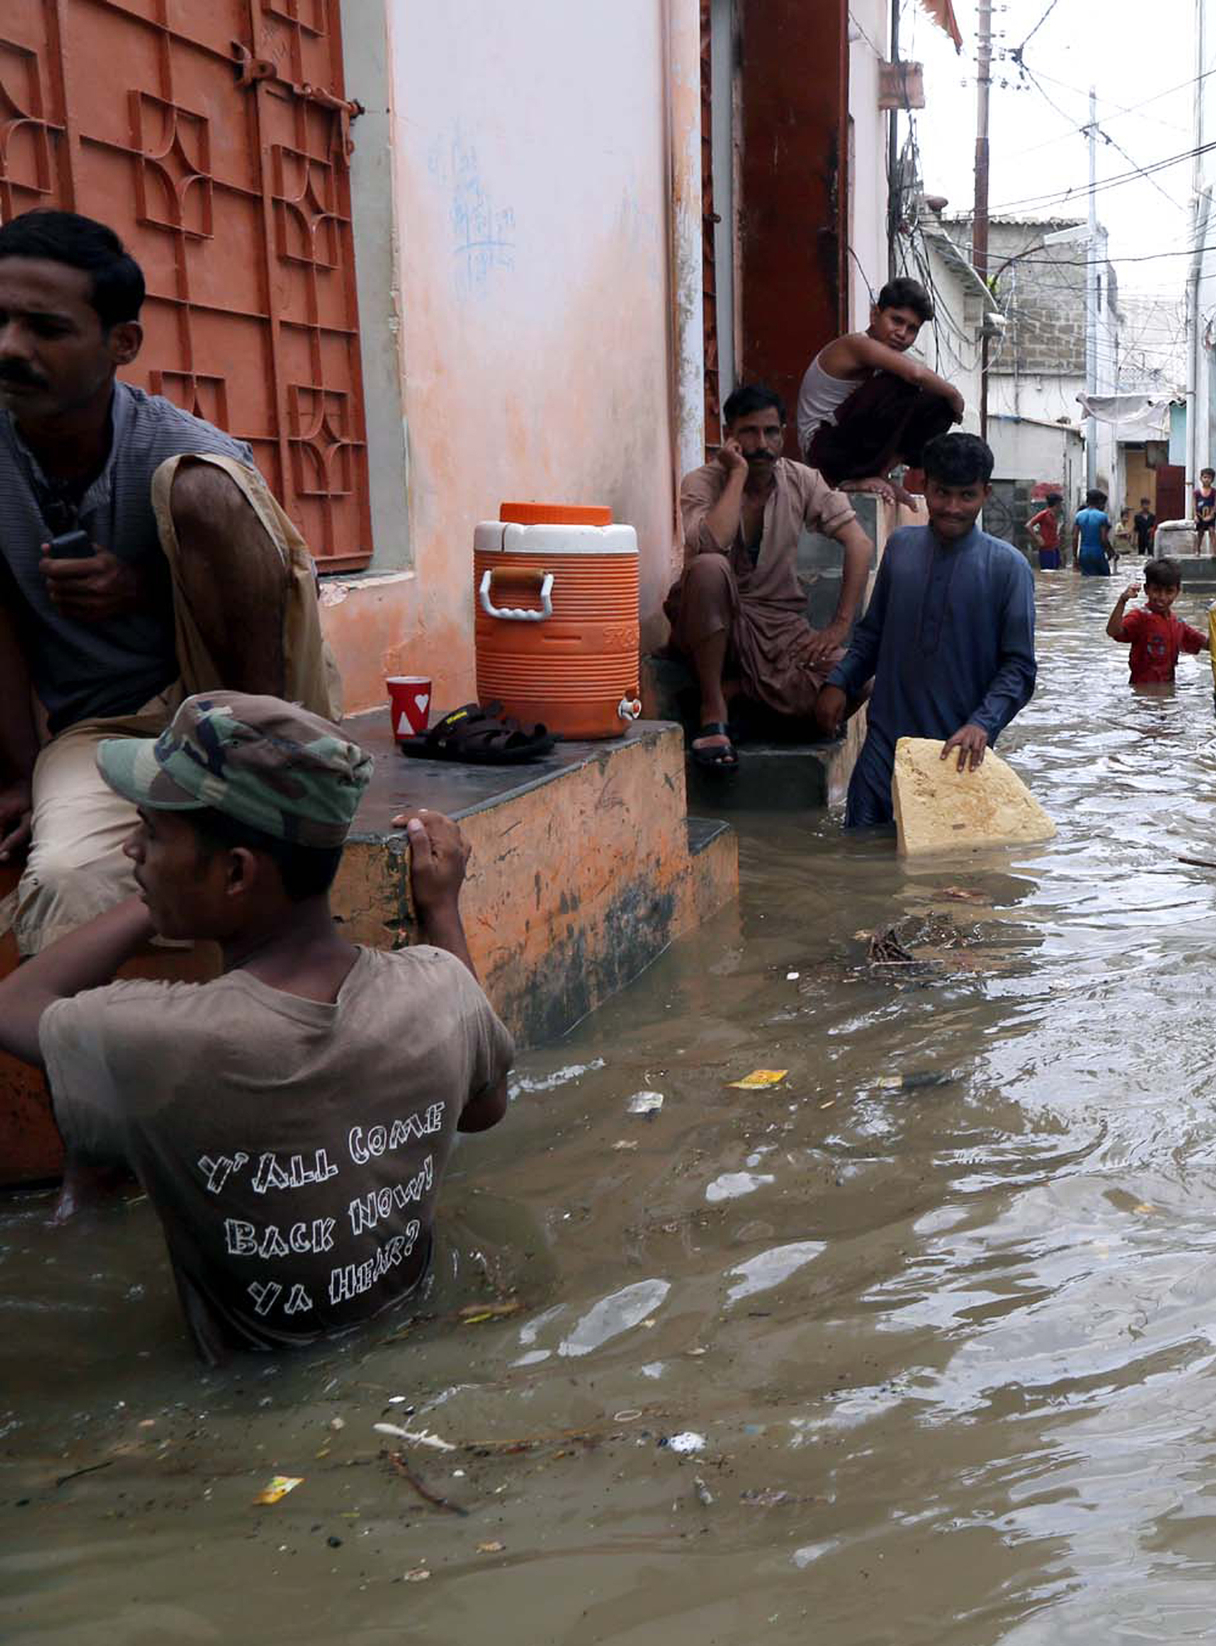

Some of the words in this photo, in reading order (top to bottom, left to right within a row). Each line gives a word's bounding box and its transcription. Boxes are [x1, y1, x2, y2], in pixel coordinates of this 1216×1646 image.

[197, 1149, 339, 1194] Y'ALL
[348, 1101, 446, 1165] COME
[223, 1217, 336, 1260] BACK
[347, 1154, 434, 1236] NOW!
[247, 1281, 313, 1316] YA
[328, 1219, 421, 1305] HEAR?
